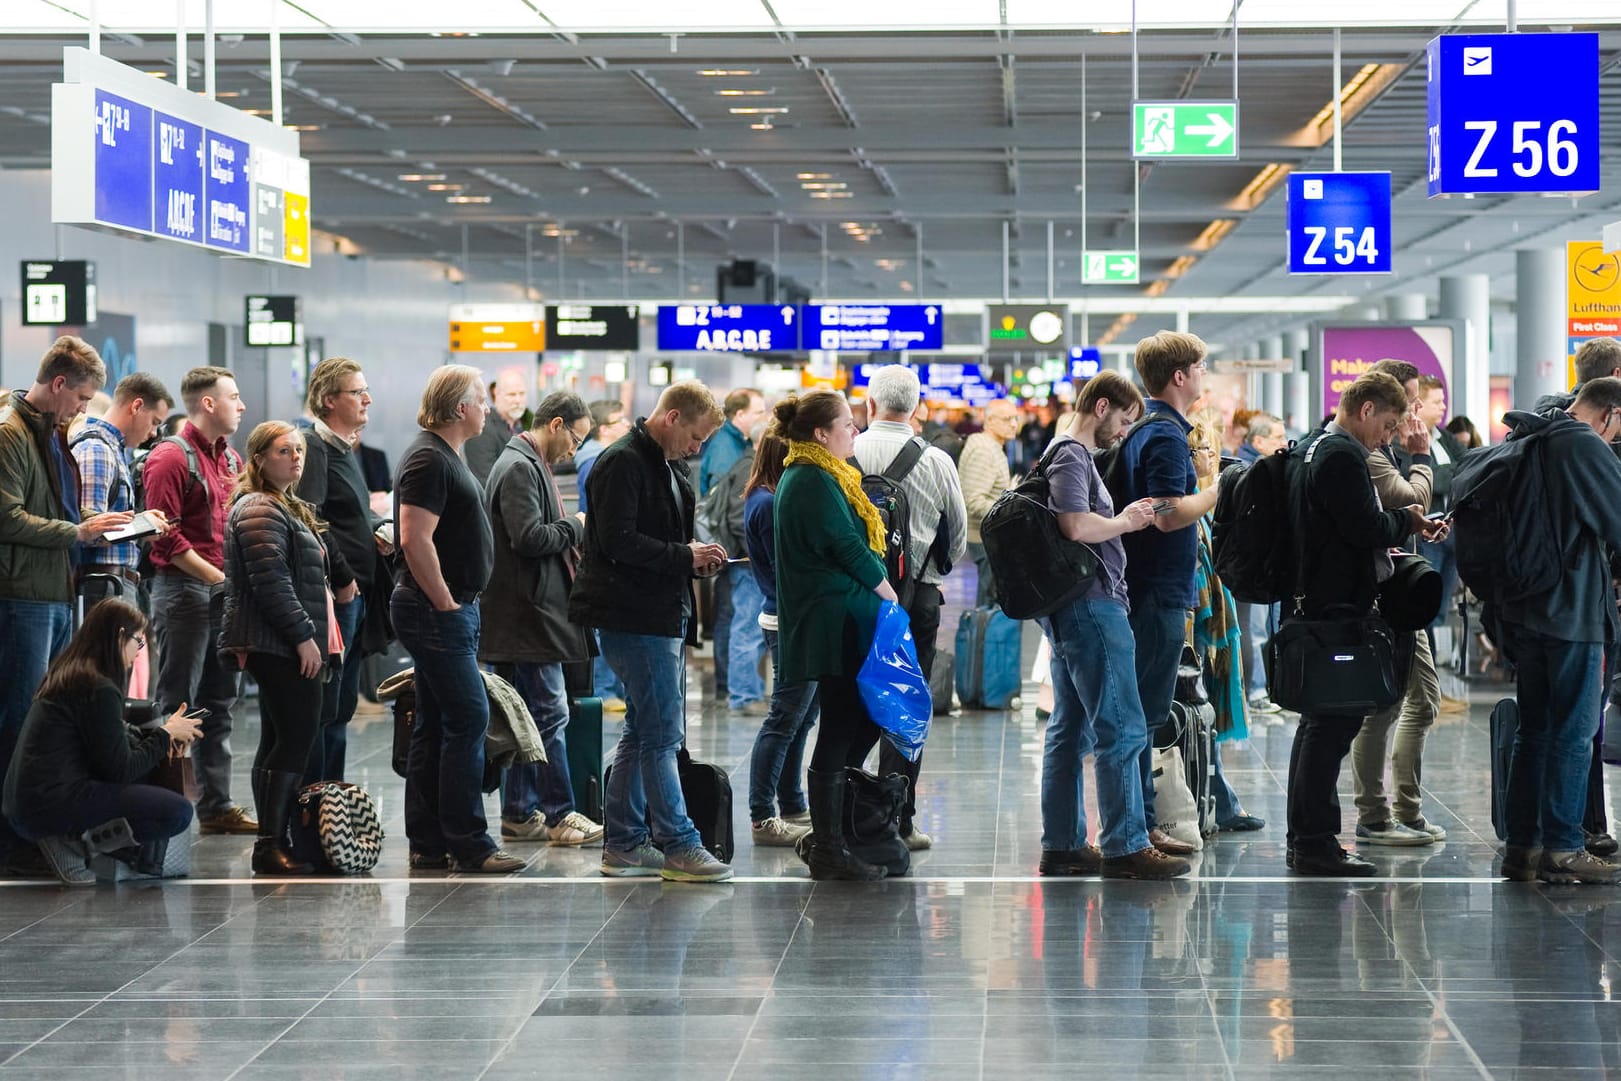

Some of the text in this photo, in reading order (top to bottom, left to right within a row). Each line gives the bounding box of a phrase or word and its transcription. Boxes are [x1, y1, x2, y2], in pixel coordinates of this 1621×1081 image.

[1463, 119, 1579, 178] Z 56
[1303, 226, 1327, 265] Z
[1334, 226, 1379, 266] 54
